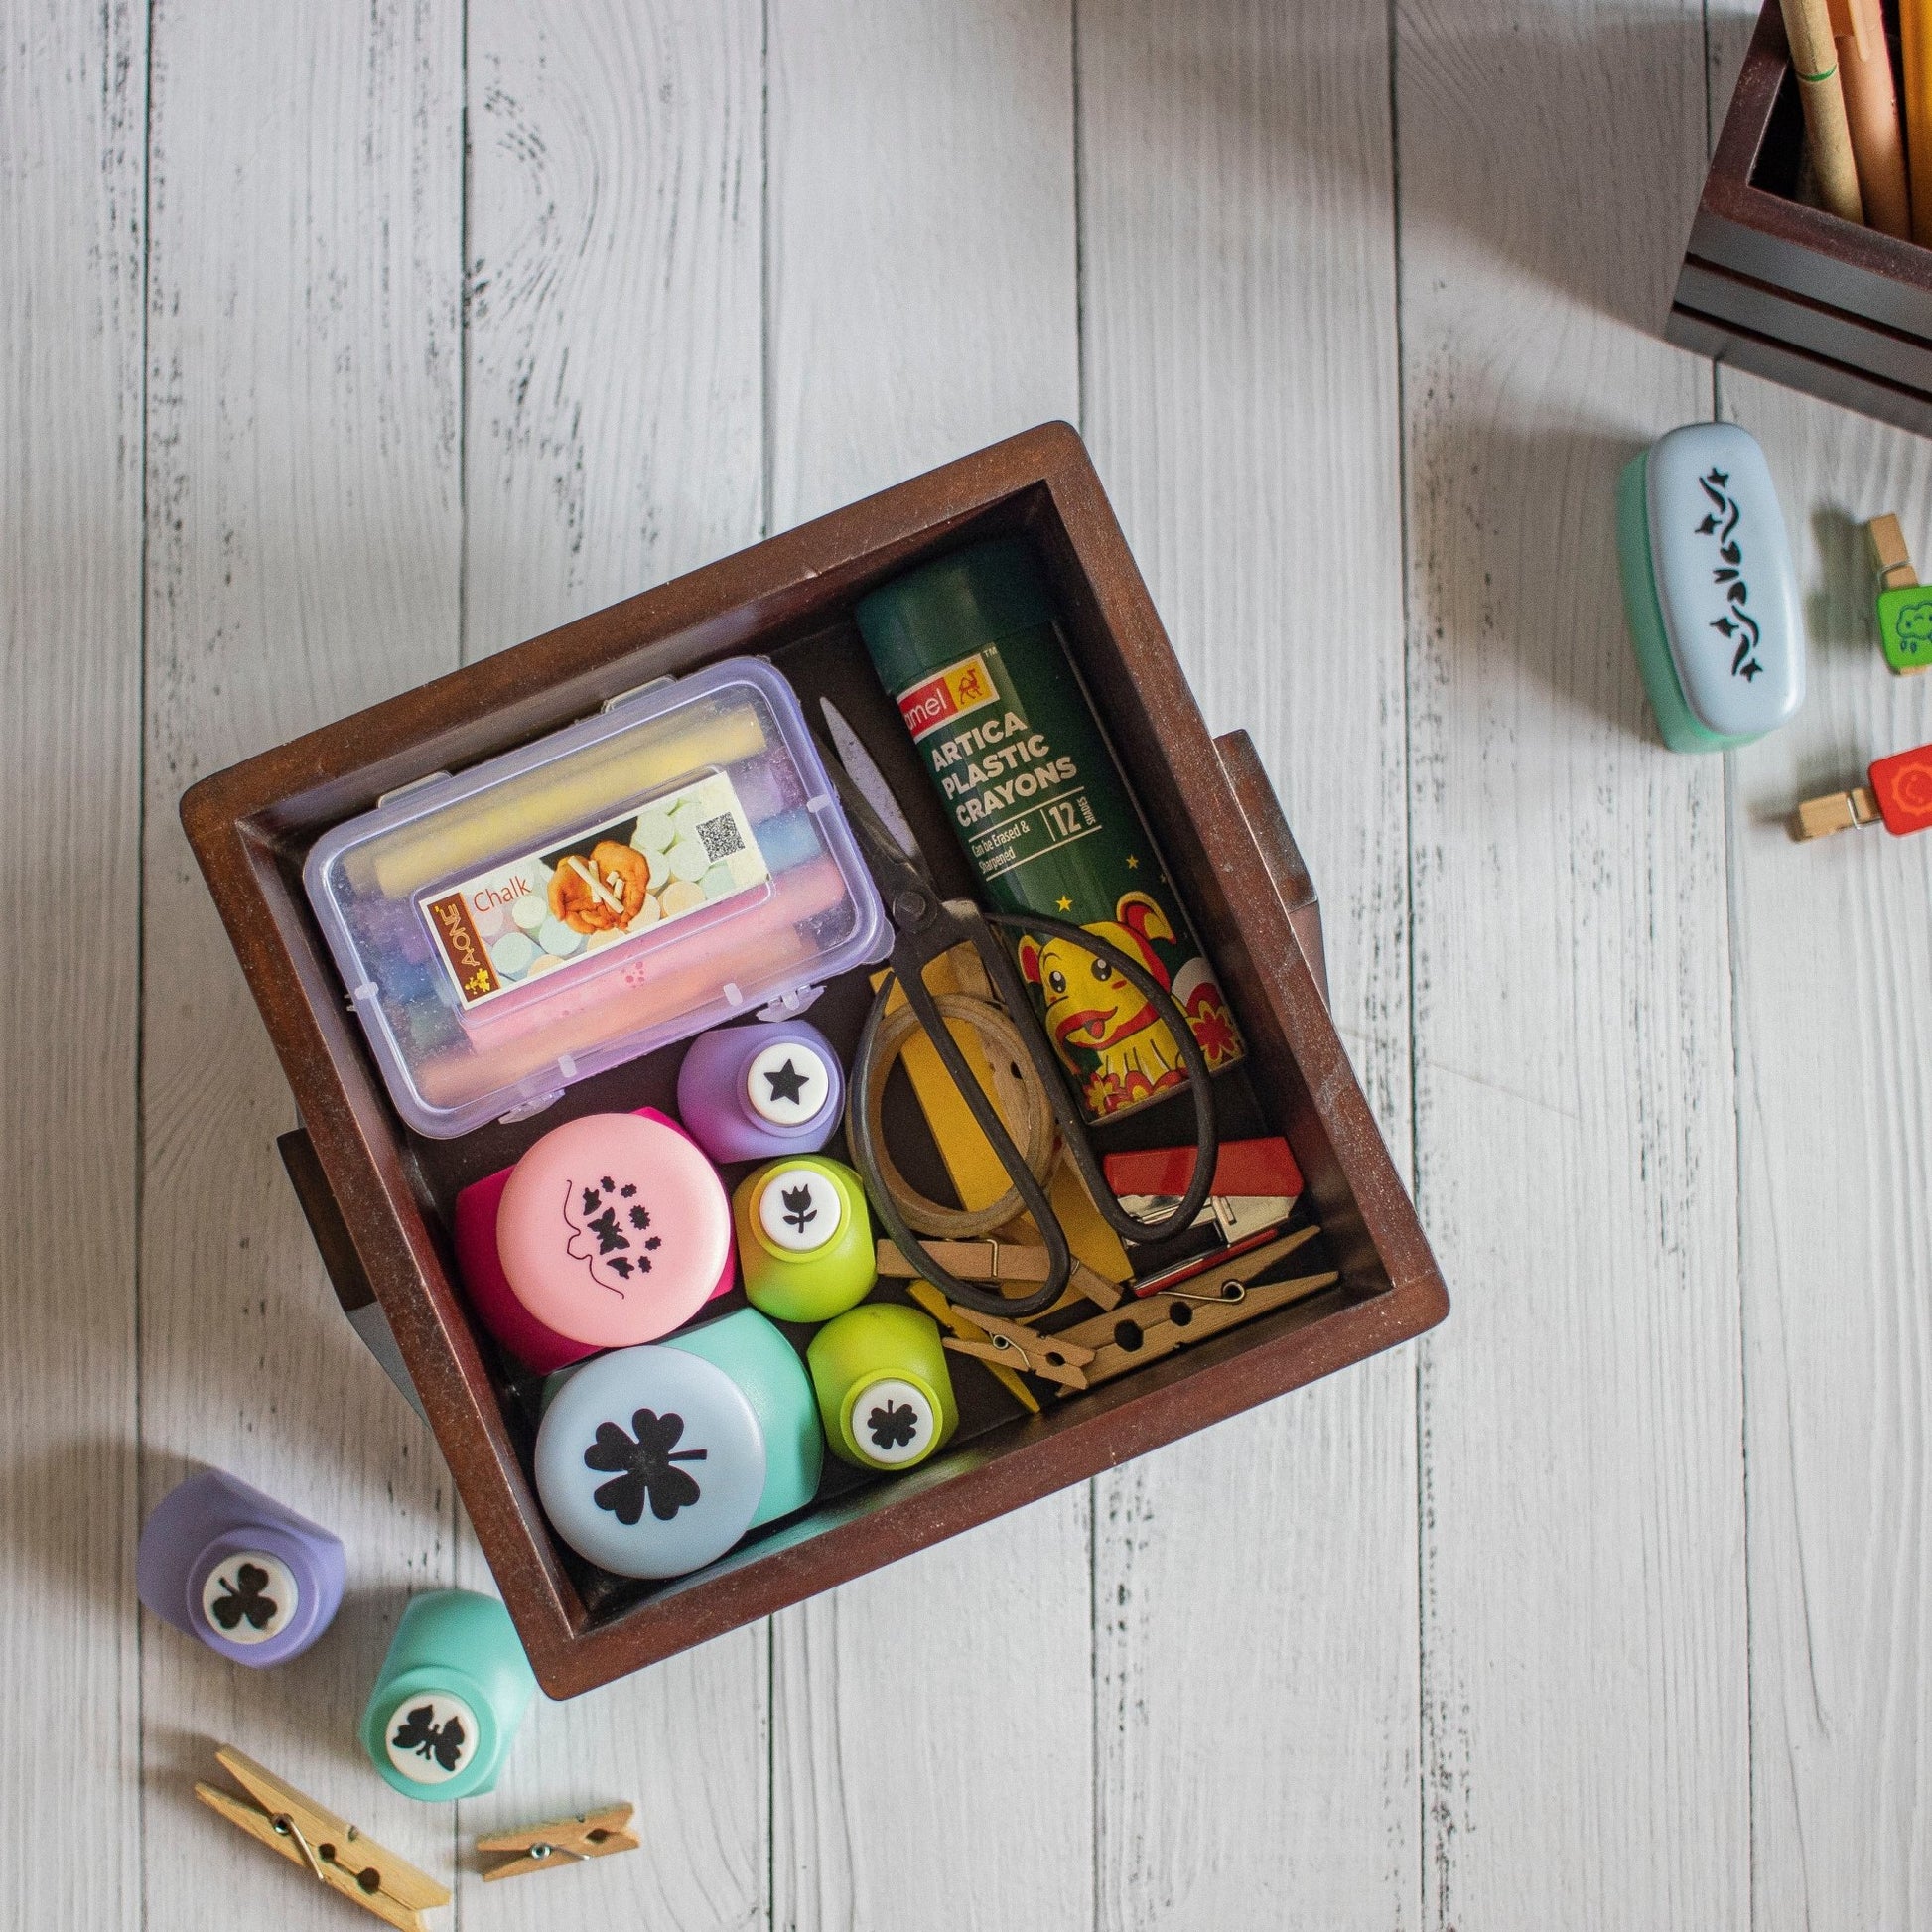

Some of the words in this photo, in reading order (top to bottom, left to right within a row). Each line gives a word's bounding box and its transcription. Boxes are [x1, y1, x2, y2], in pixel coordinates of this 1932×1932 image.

[904, 688, 947, 731] amel
[931, 711, 1028, 772] ARTICA
[942, 734, 1049, 800] PLASTIC
[955, 757, 1077, 827] CRAYONS
[1076, 796, 1096, 826] SHADES
[1048, 802, 1082, 836] 12
[971, 843, 985, 858] Can
[982, 839, 994, 853] be
[991, 823, 1022, 847] Erased
[1020, 820, 1030, 833] &
[978, 846, 1017, 874] Sharpened
[473, 875, 532, 912] Chalk
